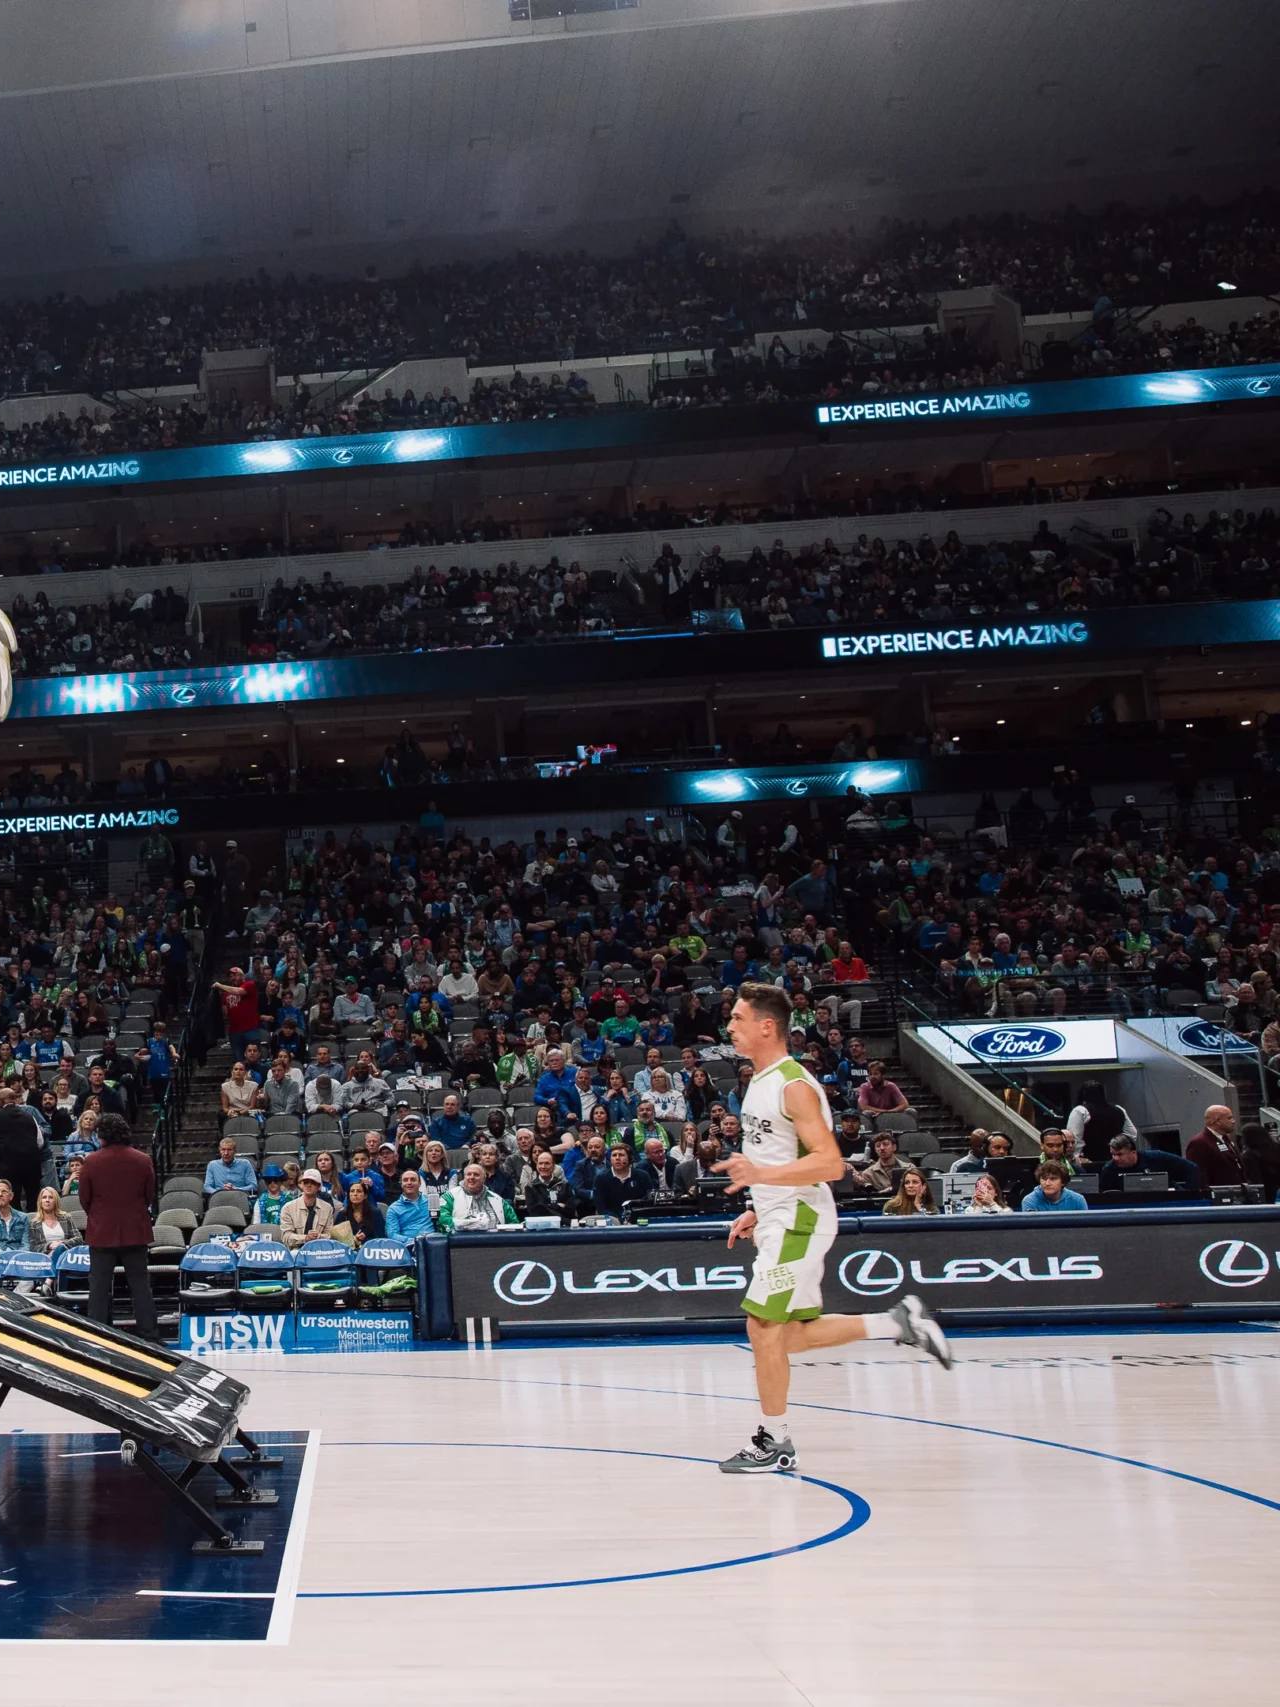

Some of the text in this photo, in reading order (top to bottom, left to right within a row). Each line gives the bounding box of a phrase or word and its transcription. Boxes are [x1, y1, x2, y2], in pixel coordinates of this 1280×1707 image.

[830, 391, 1031, 422] EXPERIENCE AMAZING
[59, 460, 140, 481] AMAZING
[838, 622, 1088, 657] EXPERIENCE AMAZING
[97, 808, 180, 828] AMAZING
[987, 1031, 1046, 1054] Ford
[67, 1253, 91, 1265] UTS
[246, 1250, 286, 1262] UTSW
[364, 1247, 405, 1260] UTSW
[562, 1265, 748, 1294] LEXUS
[910, 1255, 1104, 1285] LEXUS
[189, 1314, 286, 1345] UTSW
[301, 1316, 410, 1330] UT Southwestern
[338, 1330, 409, 1343] Medical Center
